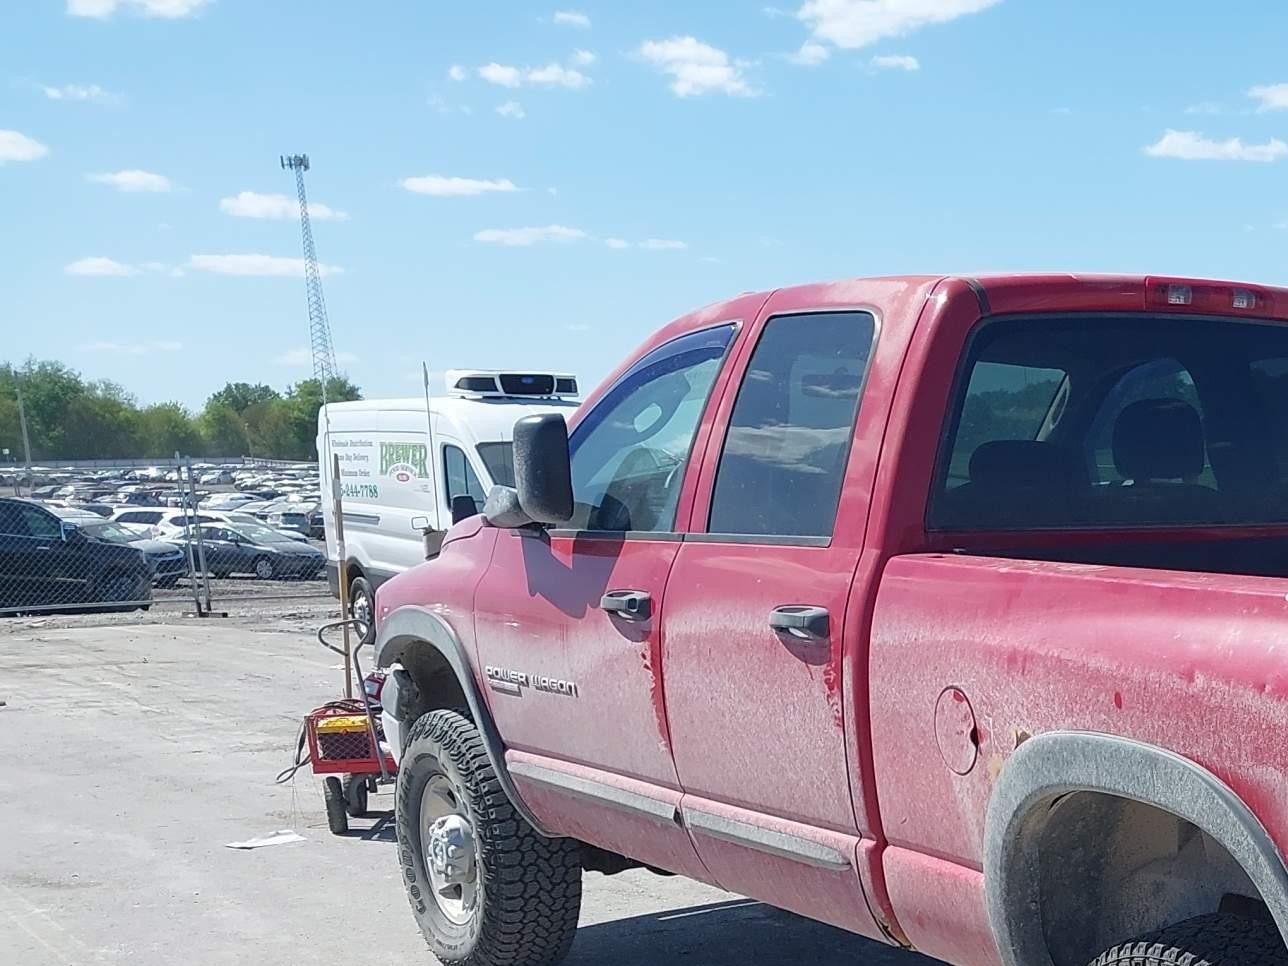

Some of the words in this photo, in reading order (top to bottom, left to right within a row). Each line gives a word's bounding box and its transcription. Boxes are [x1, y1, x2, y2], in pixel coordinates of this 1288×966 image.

[380, 441, 430, 479] BREWER
[485, 665, 527, 686] POWER
[530, 674, 578, 697] WAGON
